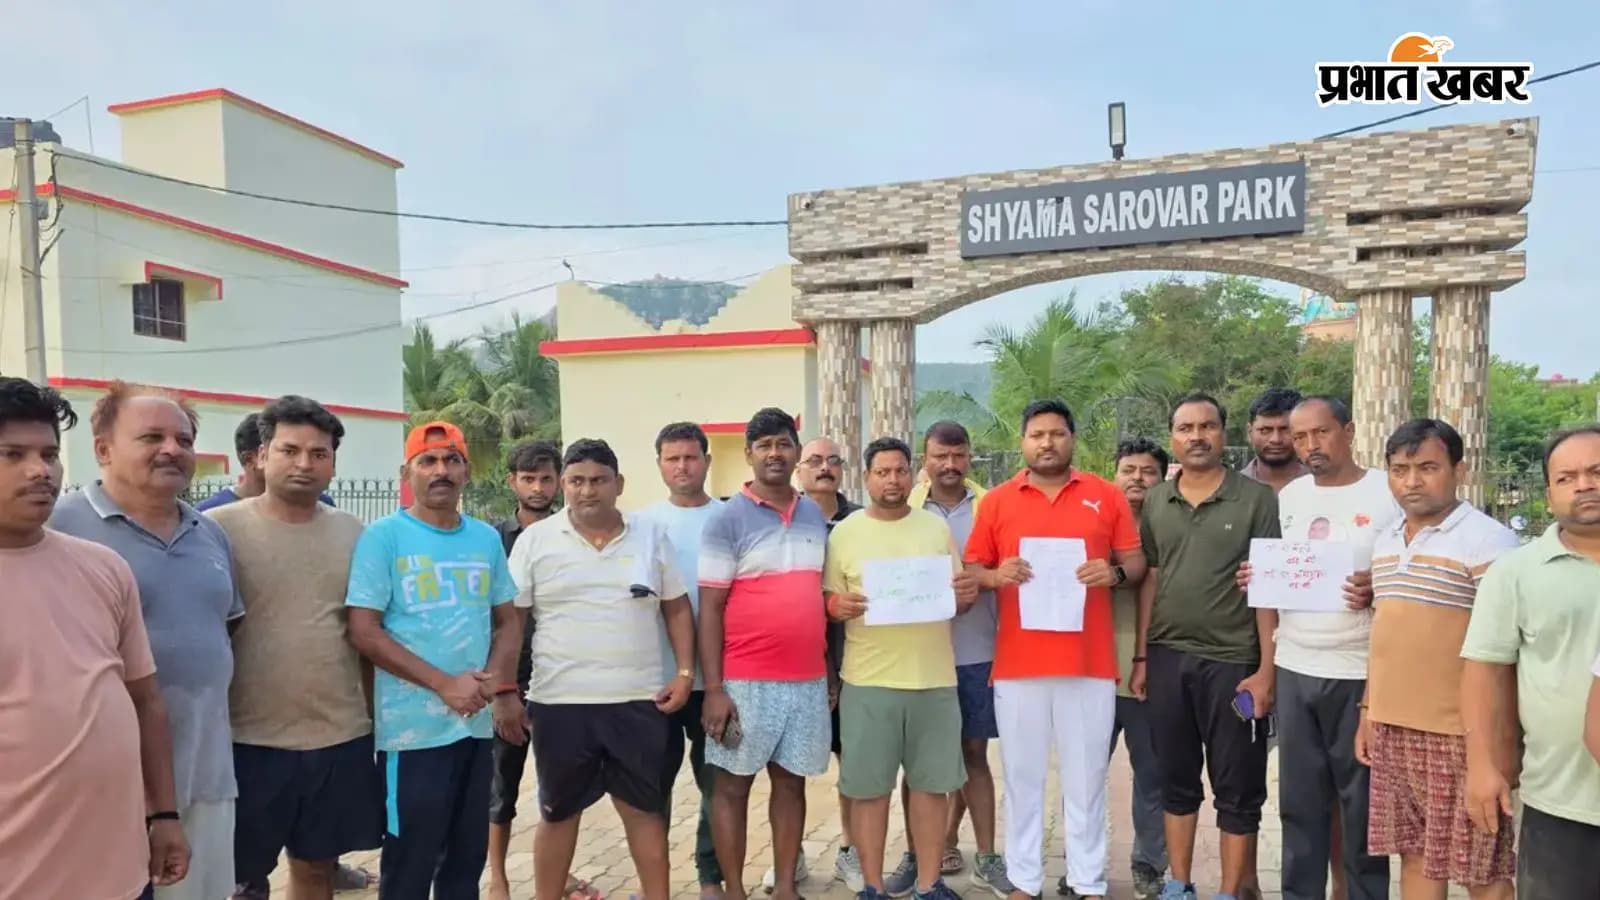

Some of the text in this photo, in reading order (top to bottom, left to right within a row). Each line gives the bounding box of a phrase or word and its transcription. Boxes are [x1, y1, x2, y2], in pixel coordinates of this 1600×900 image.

[967, 175, 1297, 244] SHYAMA SAROVAR PARK
